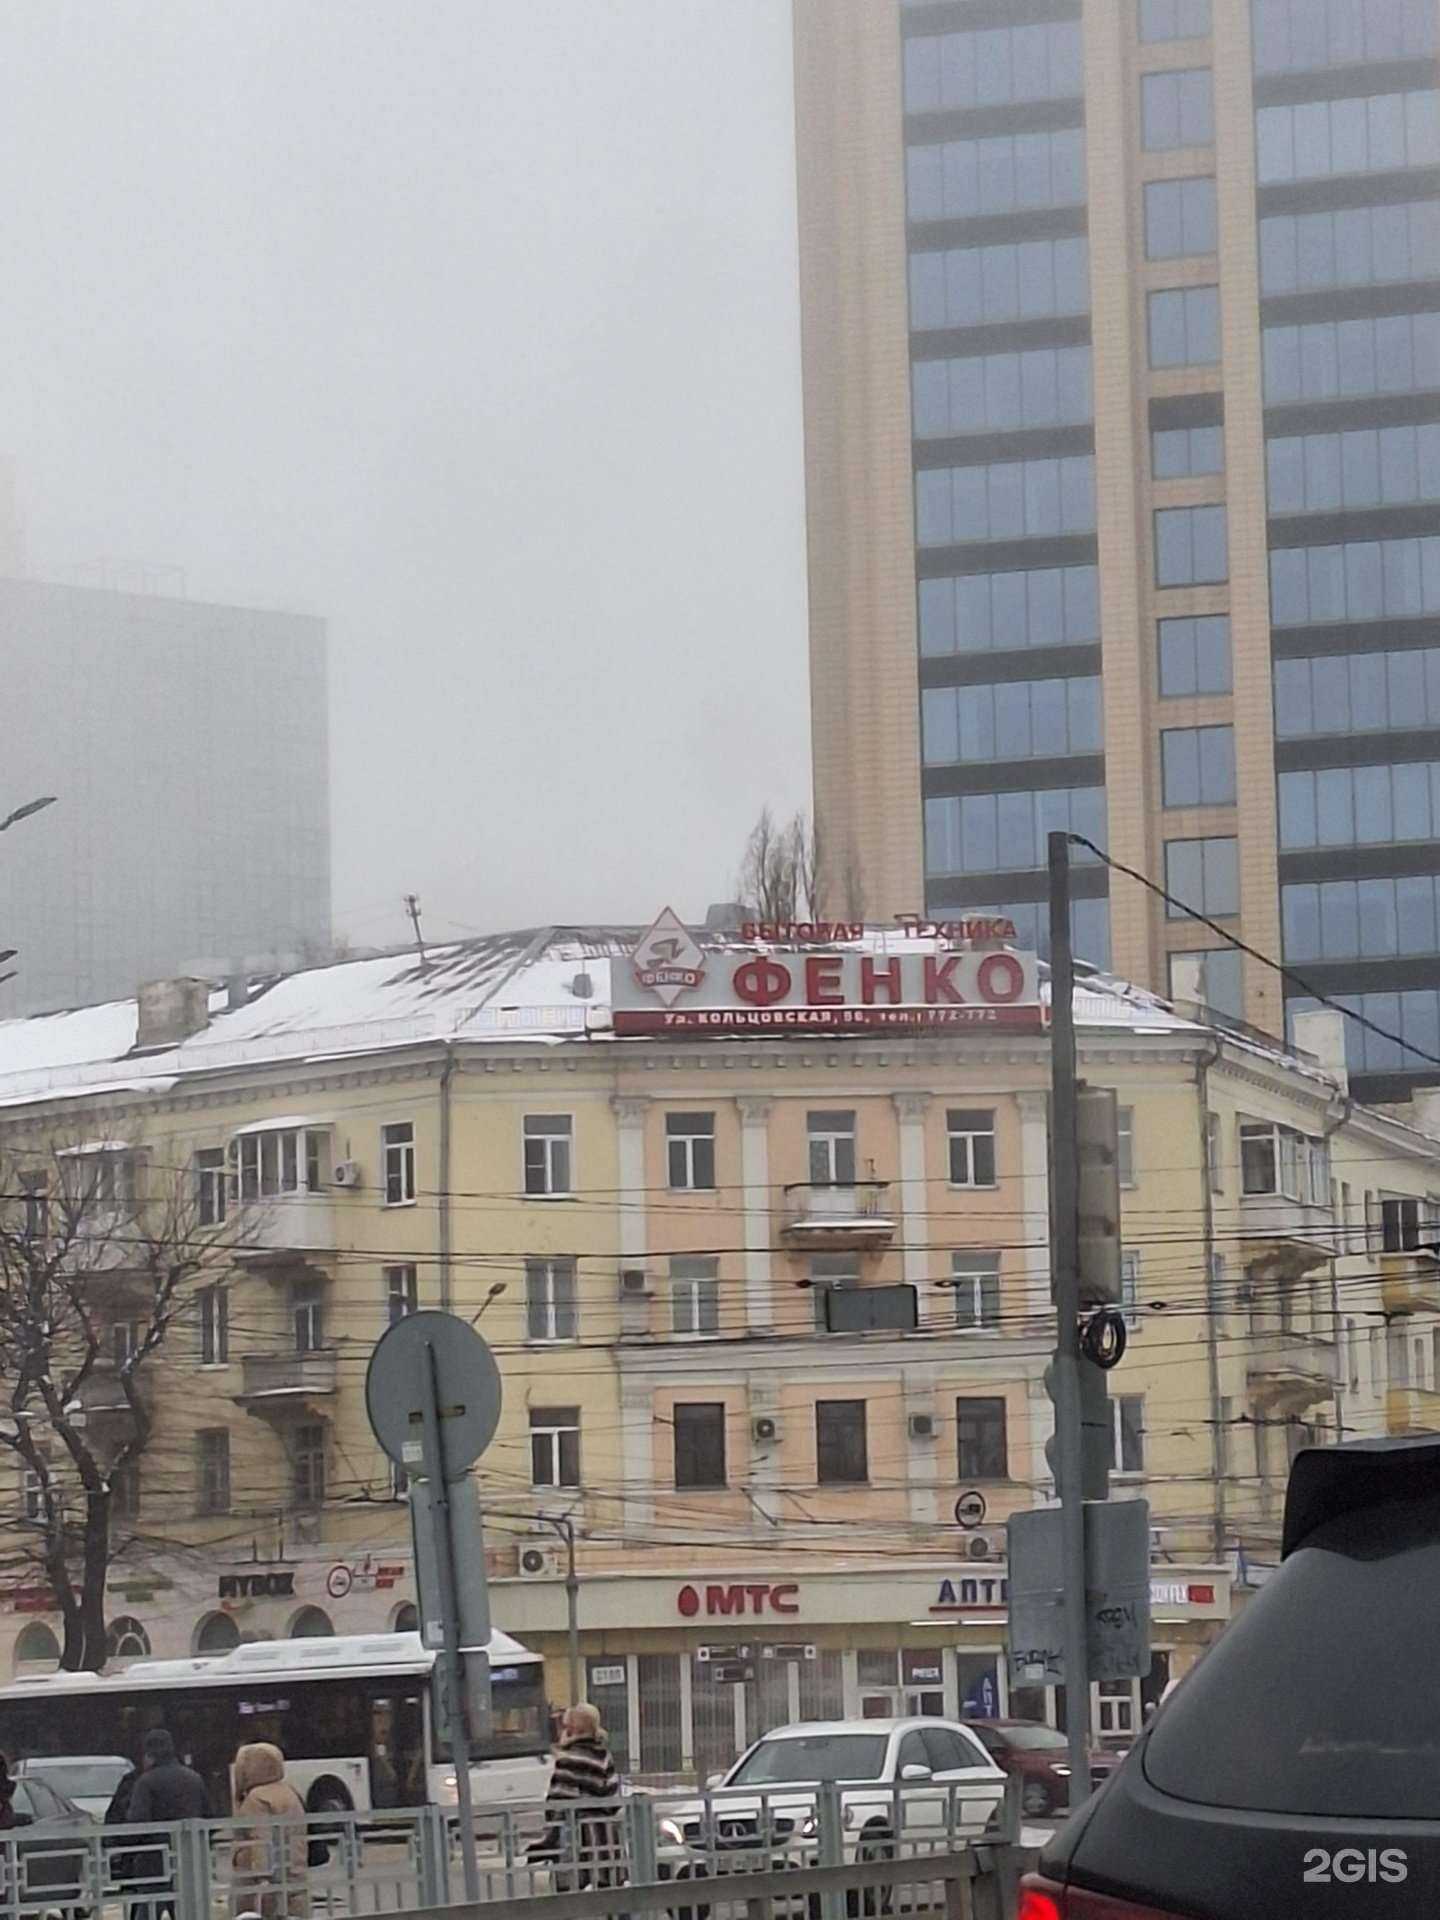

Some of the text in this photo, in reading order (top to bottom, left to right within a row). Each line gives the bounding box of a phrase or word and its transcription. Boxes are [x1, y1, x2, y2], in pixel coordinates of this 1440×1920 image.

[741, 919, 1017, 941] БЫТОВАЯ ТЕХНИКА
[733, 954, 1024, 1006] ФЕНКО
[706, 1584, 799, 1615] МТС
